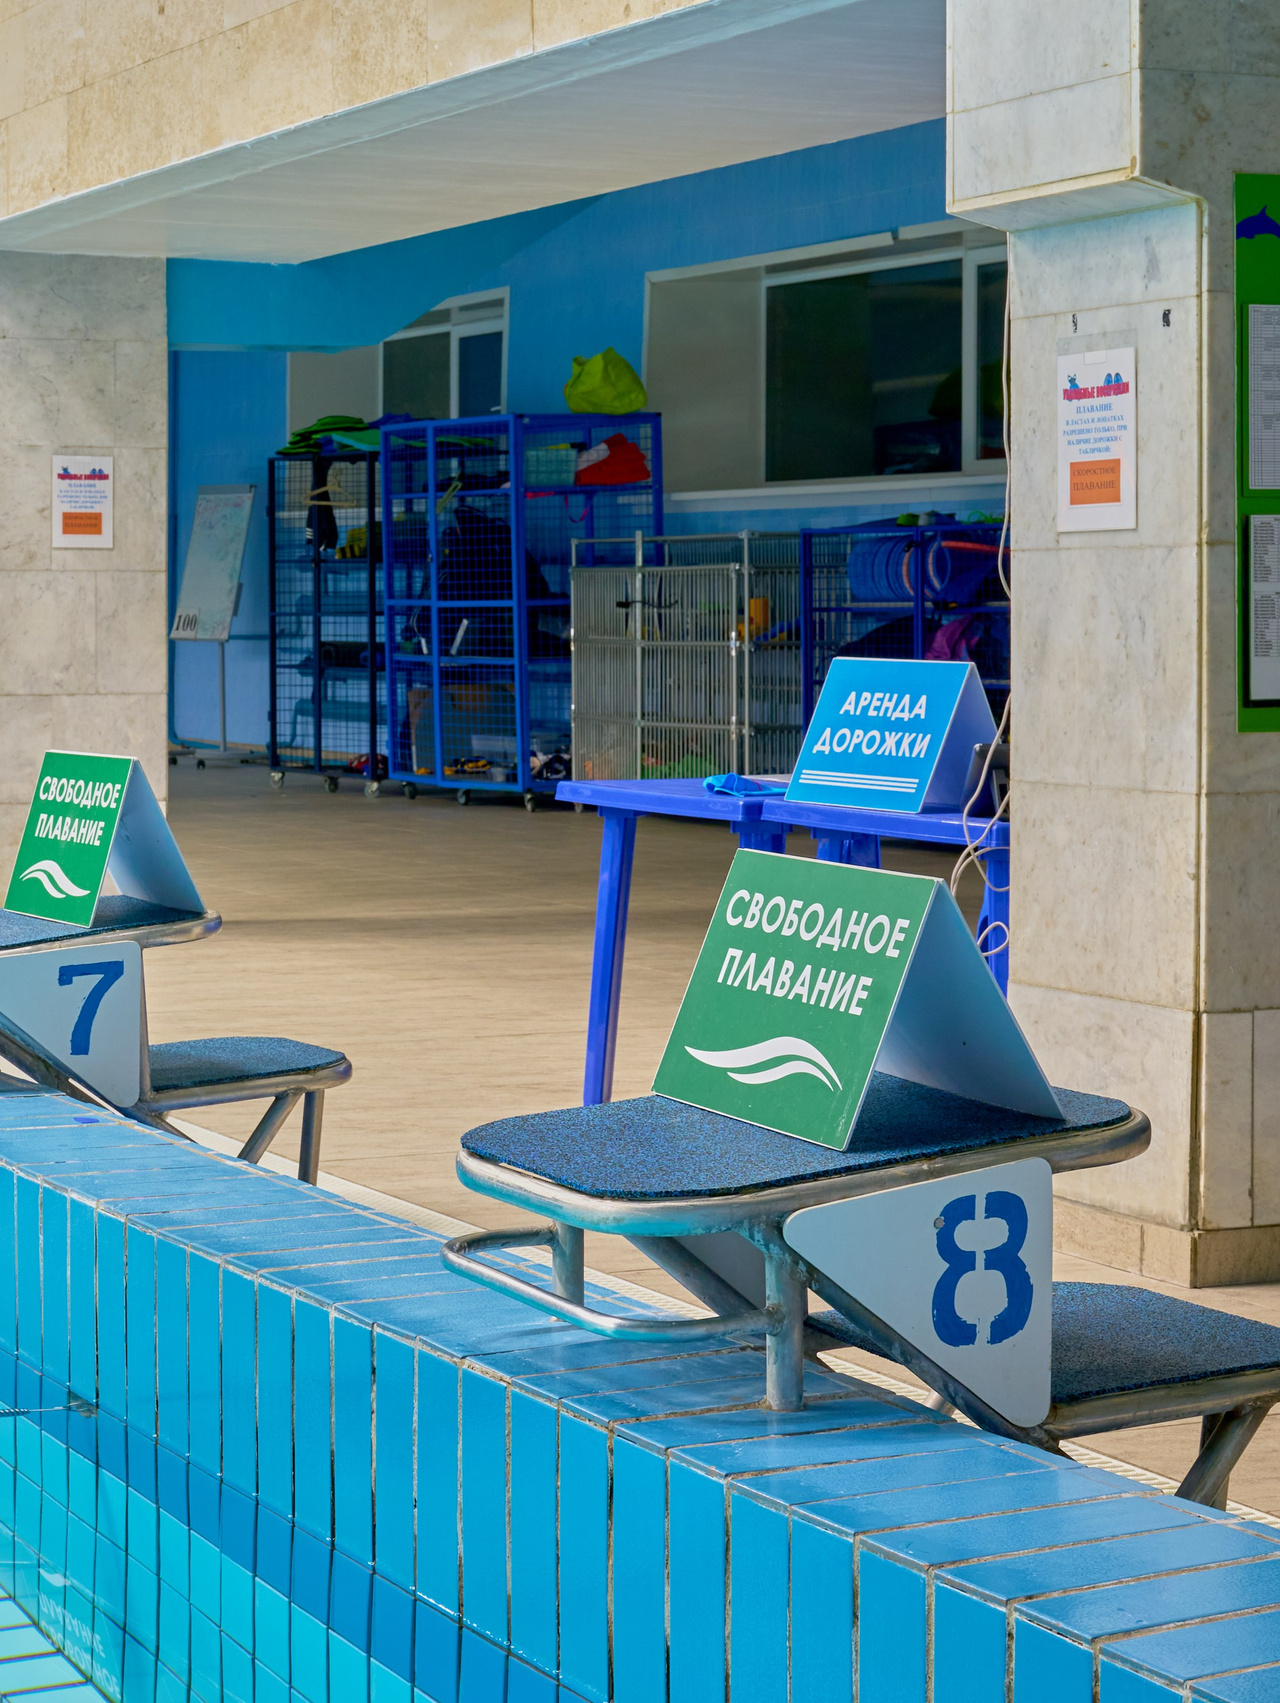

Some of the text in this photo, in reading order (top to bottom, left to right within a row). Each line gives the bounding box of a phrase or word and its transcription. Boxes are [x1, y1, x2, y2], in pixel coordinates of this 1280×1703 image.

[1076, 403, 1113, 414] ПЛАВАНИЕ
[1073, 466, 1116, 476] СКОРОСТНОЕ
[1073, 480, 1116, 491] ПЛАВАНИЕ
[175, 614, 198, 631] 100
[839, 691, 927, 721] АРЕНДА
[812, 727, 931, 758] ДОРОЖКИ
[39, 775, 122, 809] СВОБОДНОЕ
[34, 813, 105, 847] ПЛАВАНИЕ
[725, 889, 911, 958] СВОБОДНОЕ
[716, 947, 873, 1016] ПЛАВАНИЕ
[57, 960, 124, 1056] 7
[932, 1191, 1034, 1348] 8
